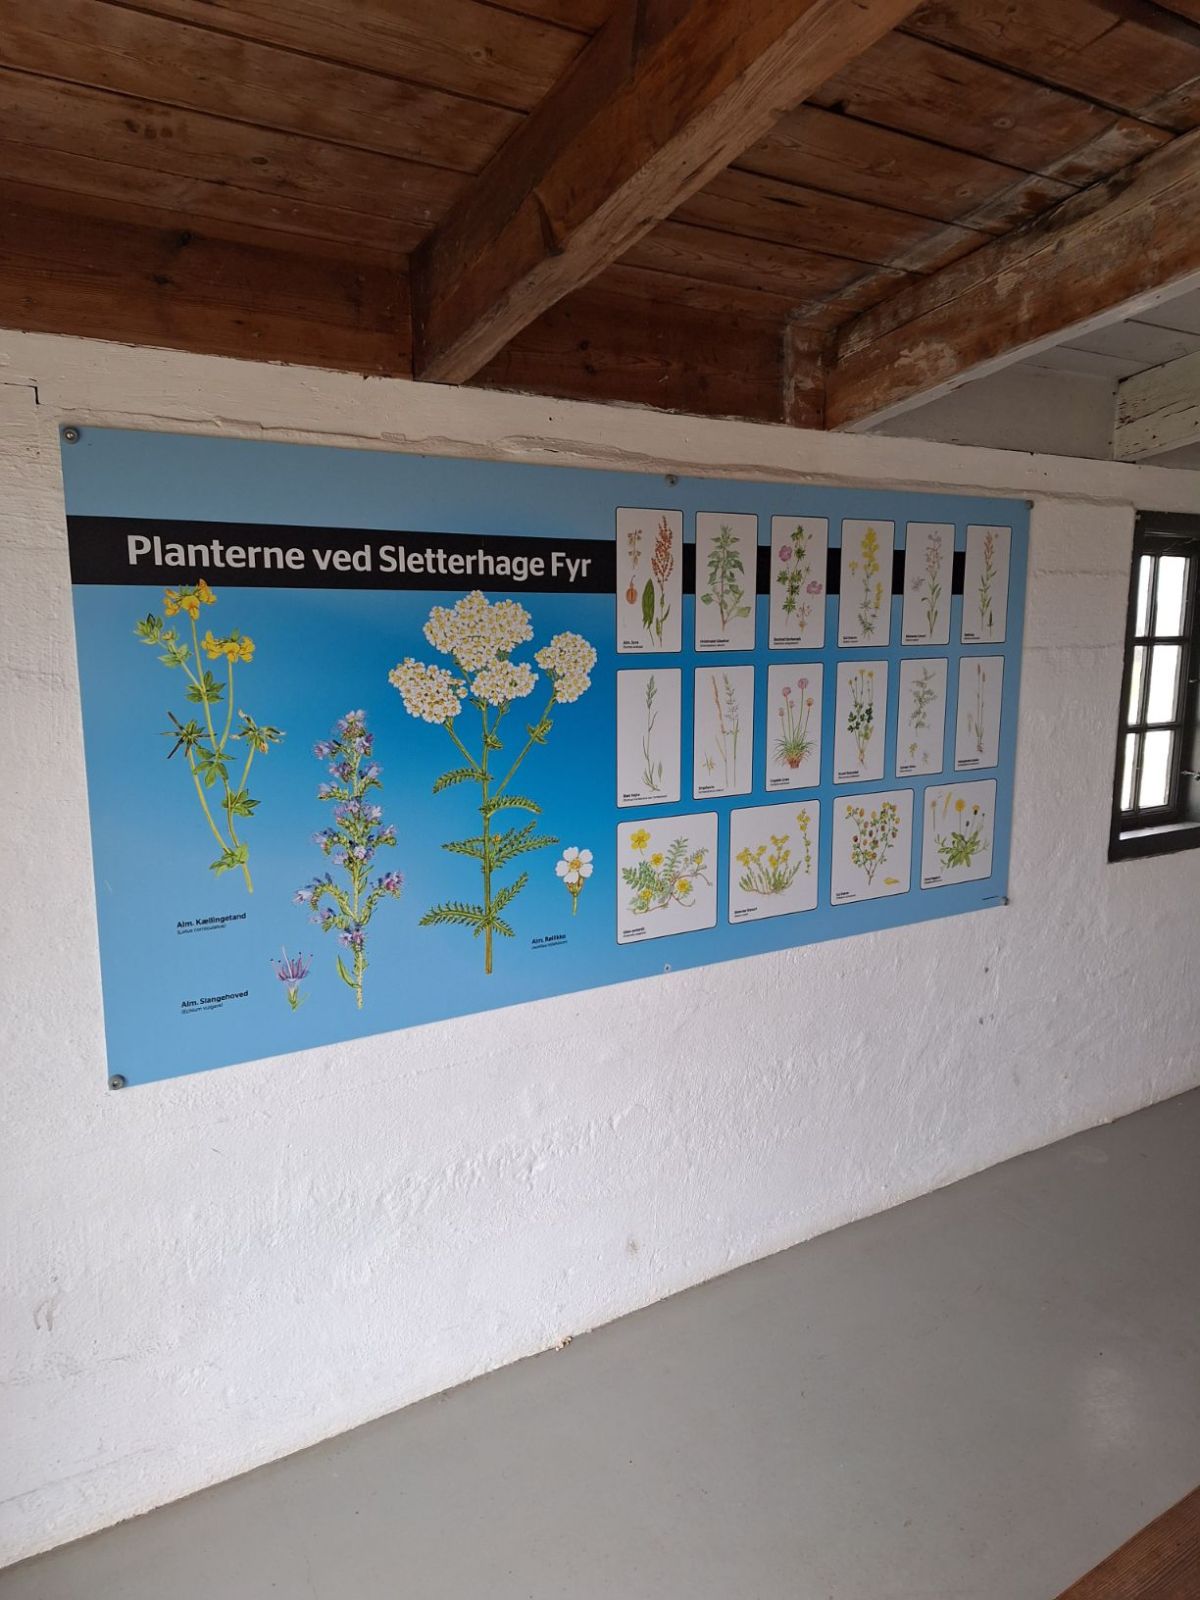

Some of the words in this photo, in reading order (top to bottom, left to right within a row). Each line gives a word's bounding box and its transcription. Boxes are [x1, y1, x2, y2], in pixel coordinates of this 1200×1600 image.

[126, 534, 305, 570] Planterne
[312, 544, 372, 572] ved
[378, 545, 545, 582] Sletterhage
[550, 552, 592, 583] Fyr
[177, 920, 194, 929] Alm.
[195, 912, 247, 926] Kællingetand
[181, 1000, 199, 1008] Alm.
[199, 990, 249, 1006] Slangehoved
